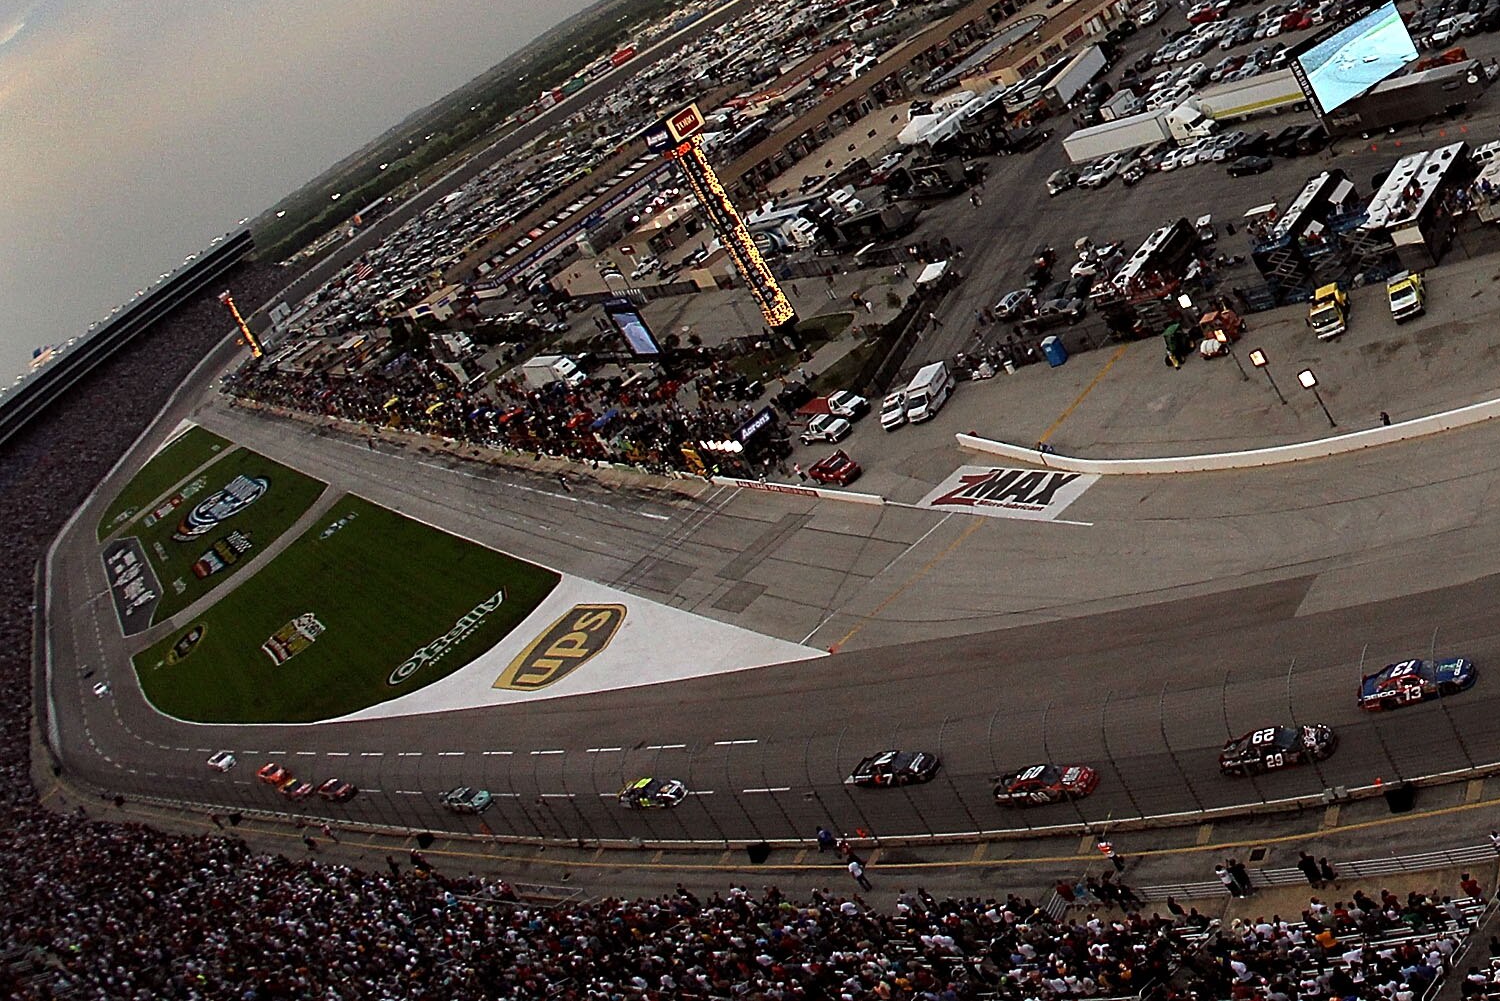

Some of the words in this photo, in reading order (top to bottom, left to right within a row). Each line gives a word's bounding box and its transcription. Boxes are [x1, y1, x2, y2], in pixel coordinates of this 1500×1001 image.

[1331, 14, 1357, 34] GALAXY
[1290, 60, 1312, 97] SAMSUNG
[675, 113, 696, 132] TORO
[741, 412, 771, 441] Aaron's
[428, 643, 454, 668] AUTO
[455, 618, 487, 645] PARTS
[1390, 660, 1416, 678] 13
[1362, 689, 1397, 702] GEICO
[1402, 685, 1422, 701] 13
[1252, 727, 1275, 745] 29
[1265, 752, 1284, 768] 29
[883, 773, 893, 785] 7
